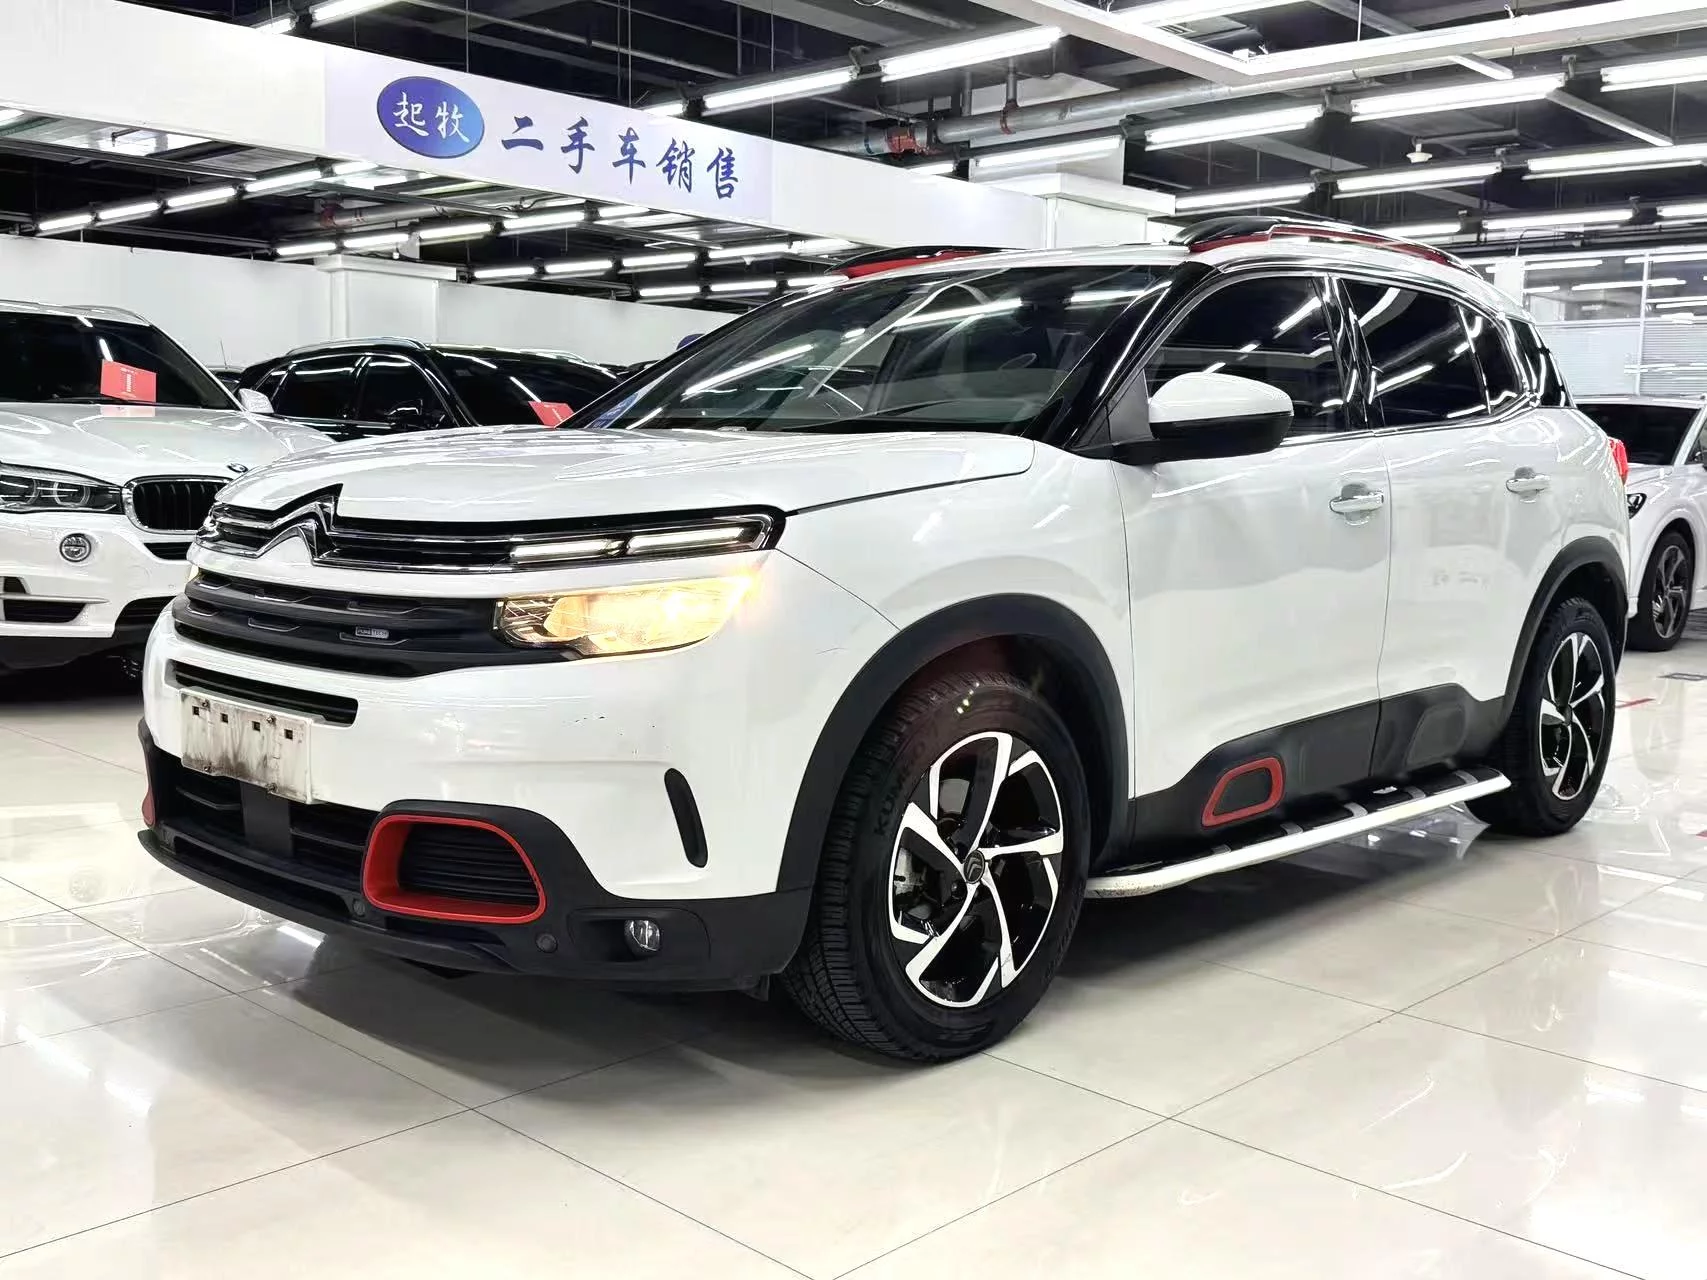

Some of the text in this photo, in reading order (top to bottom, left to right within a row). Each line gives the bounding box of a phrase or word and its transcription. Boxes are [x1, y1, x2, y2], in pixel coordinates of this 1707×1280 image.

[393, 91, 739, 199] 起牧 二手车销售
